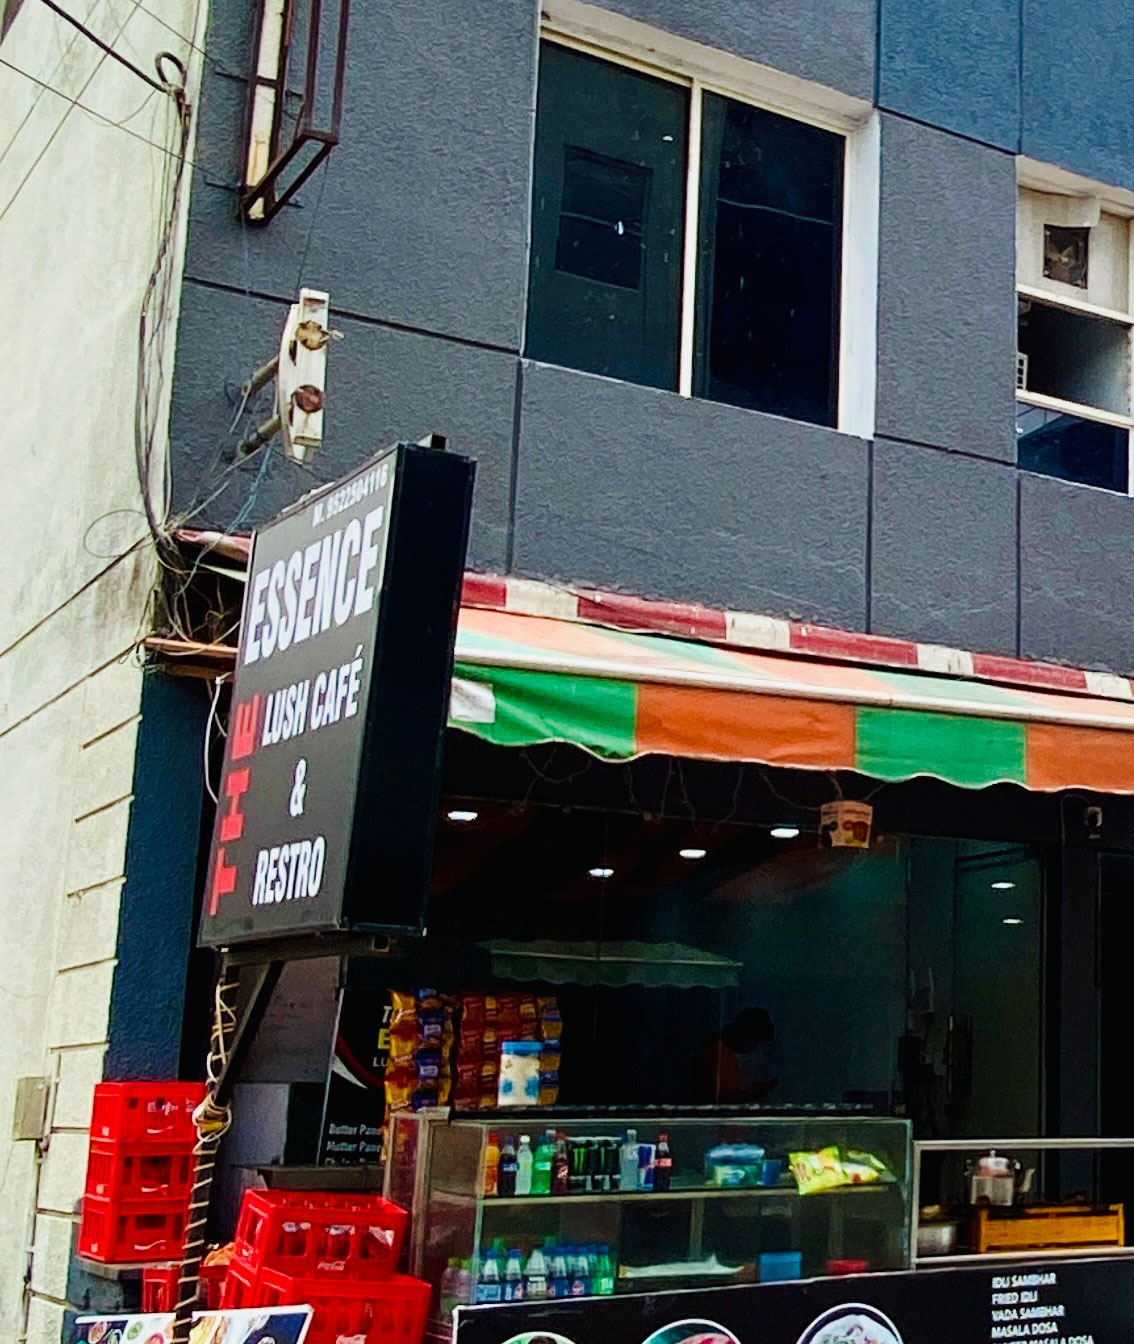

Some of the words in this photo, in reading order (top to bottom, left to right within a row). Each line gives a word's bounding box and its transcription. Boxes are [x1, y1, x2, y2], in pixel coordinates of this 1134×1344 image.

[243, 505, 384, 665] ESSENCE
[261, 679, 310, 746] LUSH
[310, 644, 364, 730] CAFÉ
[208, 692, 262, 916] THE
[289, 758, 307, 817] &
[252, 836, 326, 906] RESTRO
[991, 1324, 1031, 1338] MASALA
[1032, 1321, 1058, 1335] DOSA
[992, 1309, 1018, 1322] VADA
